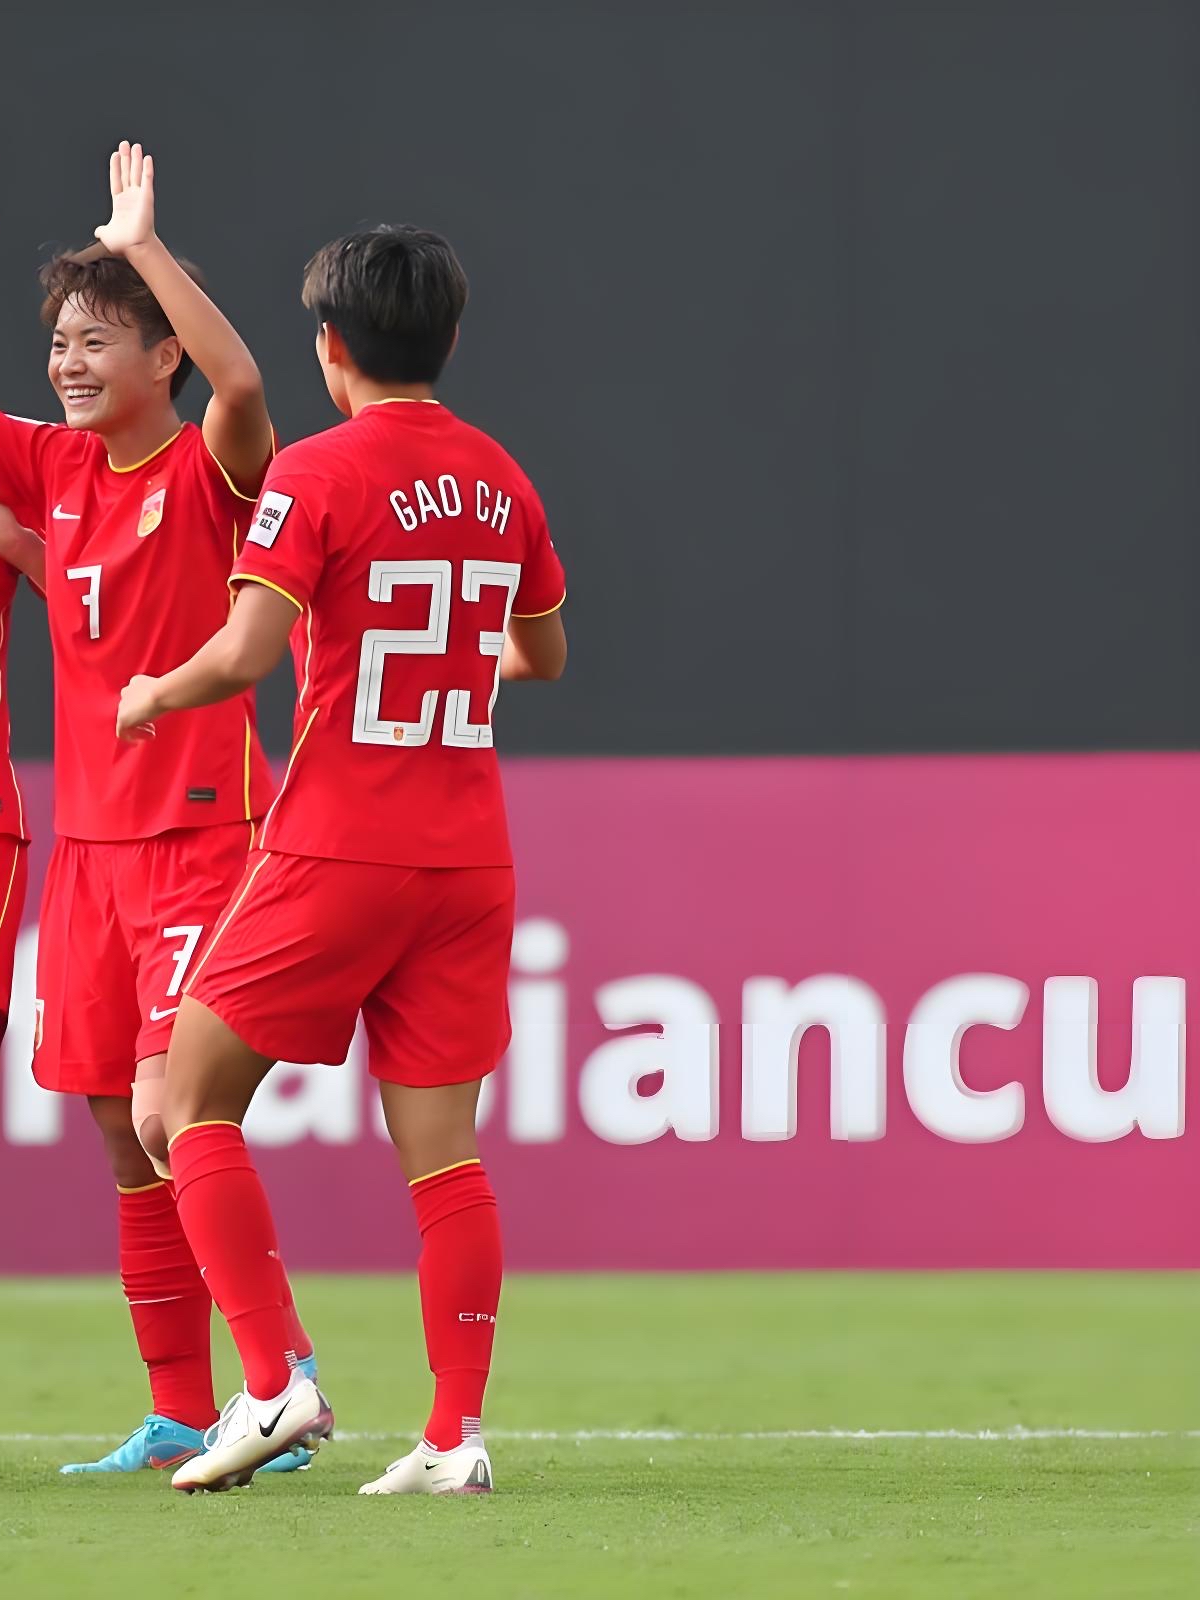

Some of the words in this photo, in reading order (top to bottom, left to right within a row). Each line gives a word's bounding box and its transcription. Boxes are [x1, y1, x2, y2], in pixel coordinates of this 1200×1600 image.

[389, 474, 463, 532] GAO
[476, 479, 513, 536] CH
[66, 564, 102, 640] 7
[351, 559, 522, 749] 23
[162, 924, 204, 998] 7
